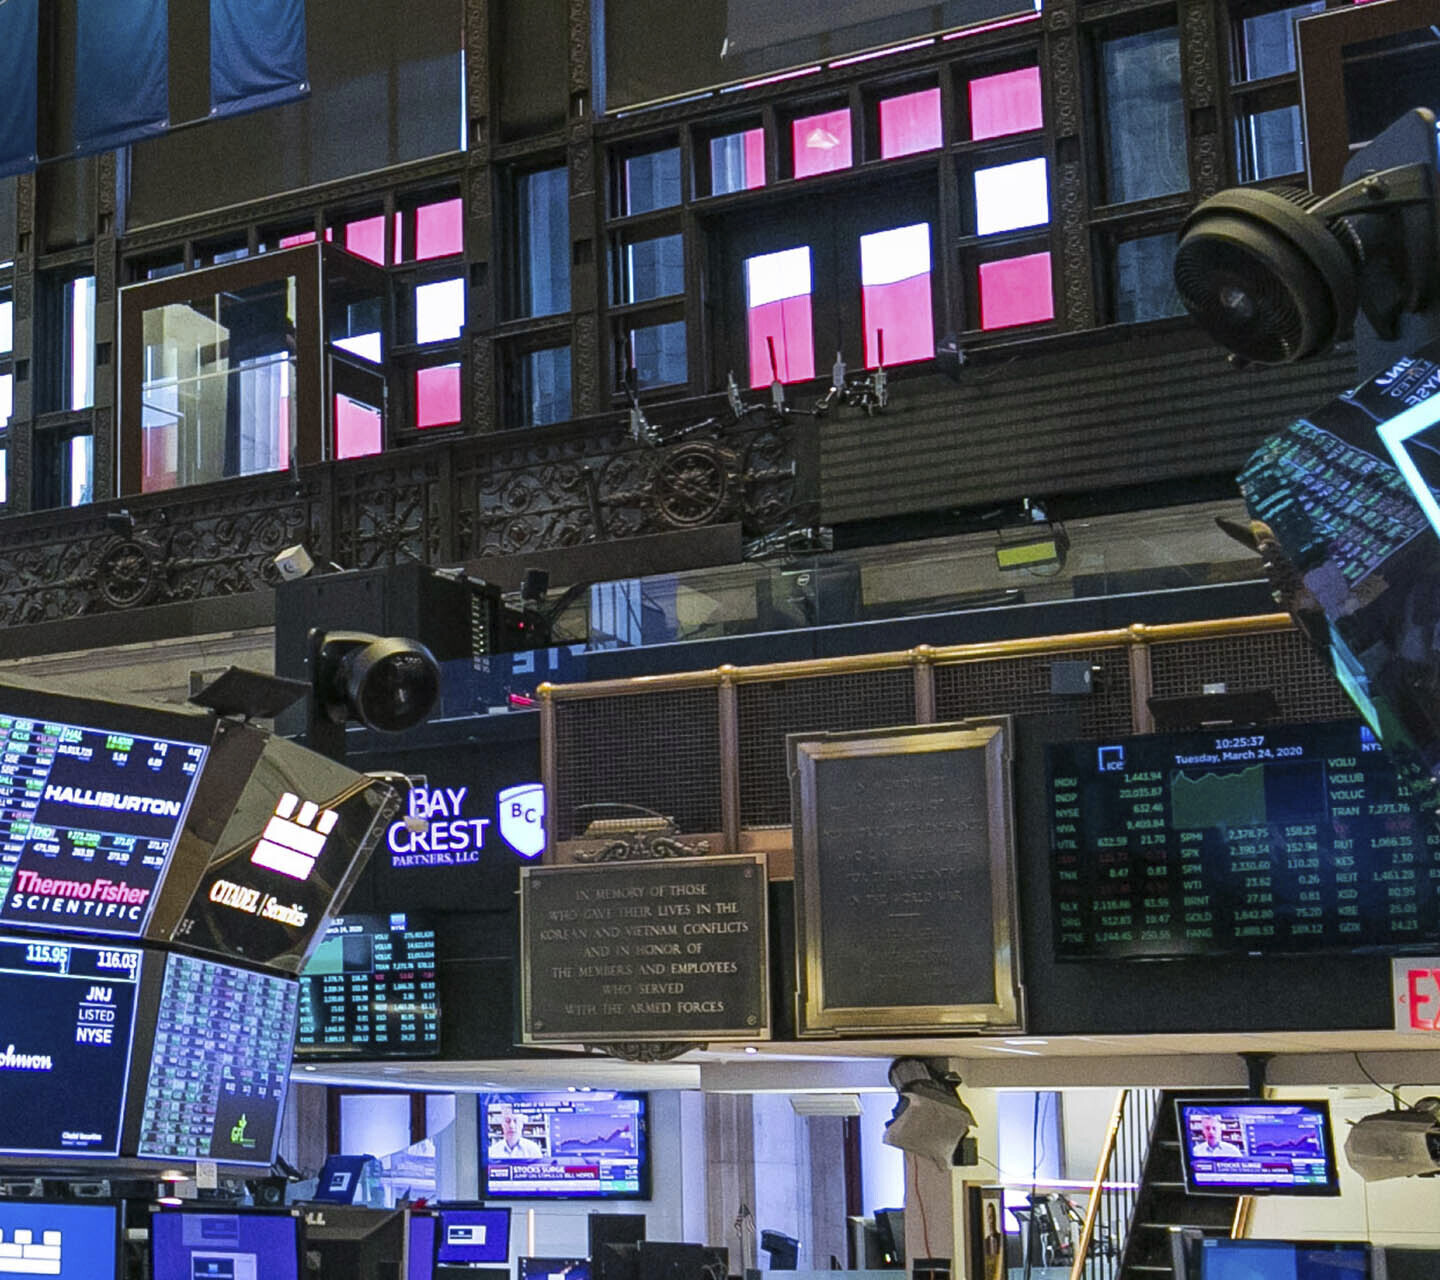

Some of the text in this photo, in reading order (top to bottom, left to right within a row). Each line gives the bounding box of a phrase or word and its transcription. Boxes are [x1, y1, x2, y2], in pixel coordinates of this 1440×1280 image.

[1216, 736, 1265, 750] 10:25:37
[1175, 746, 1303, 765] Tuesday, March 24, 2020
[44, 784, 181, 817] HALLIBURTON
[408, 787, 467, 818] BAY
[511, 802, 536, 823] B C
[387, 817, 489, 853] CREST
[392, 850, 479, 867] PARTNERS, LLC
[17, 869, 149, 906] ThermoFisher
[670, 884, 708, 896] THOSE
[11, 894, 141, 921] SCIENTIFIC
[209, 879, 308, 928] CITADEL Securities
[658, 904, 691, 917] LIVES
[697, 903, 711, 914] IN
[716, 902, 739, 913] THE
[683, 922, 749, 936] CONFLICTS
[25, 945, 68, 964] 115.95
[687, 943, 703, 954] OF
[671, 961, 737, 974] EMPLOYEES
[85, 986, 113, 1002] JNJ
[639, 983, 684, 994] SERVED
[78, 1009, 115, 1022] LISTED
[630, 1002, 671, 1014] ARMED
[677, 1001, 725, 1013] FORCES
[75, 1028, 113, 1044] NYSE
